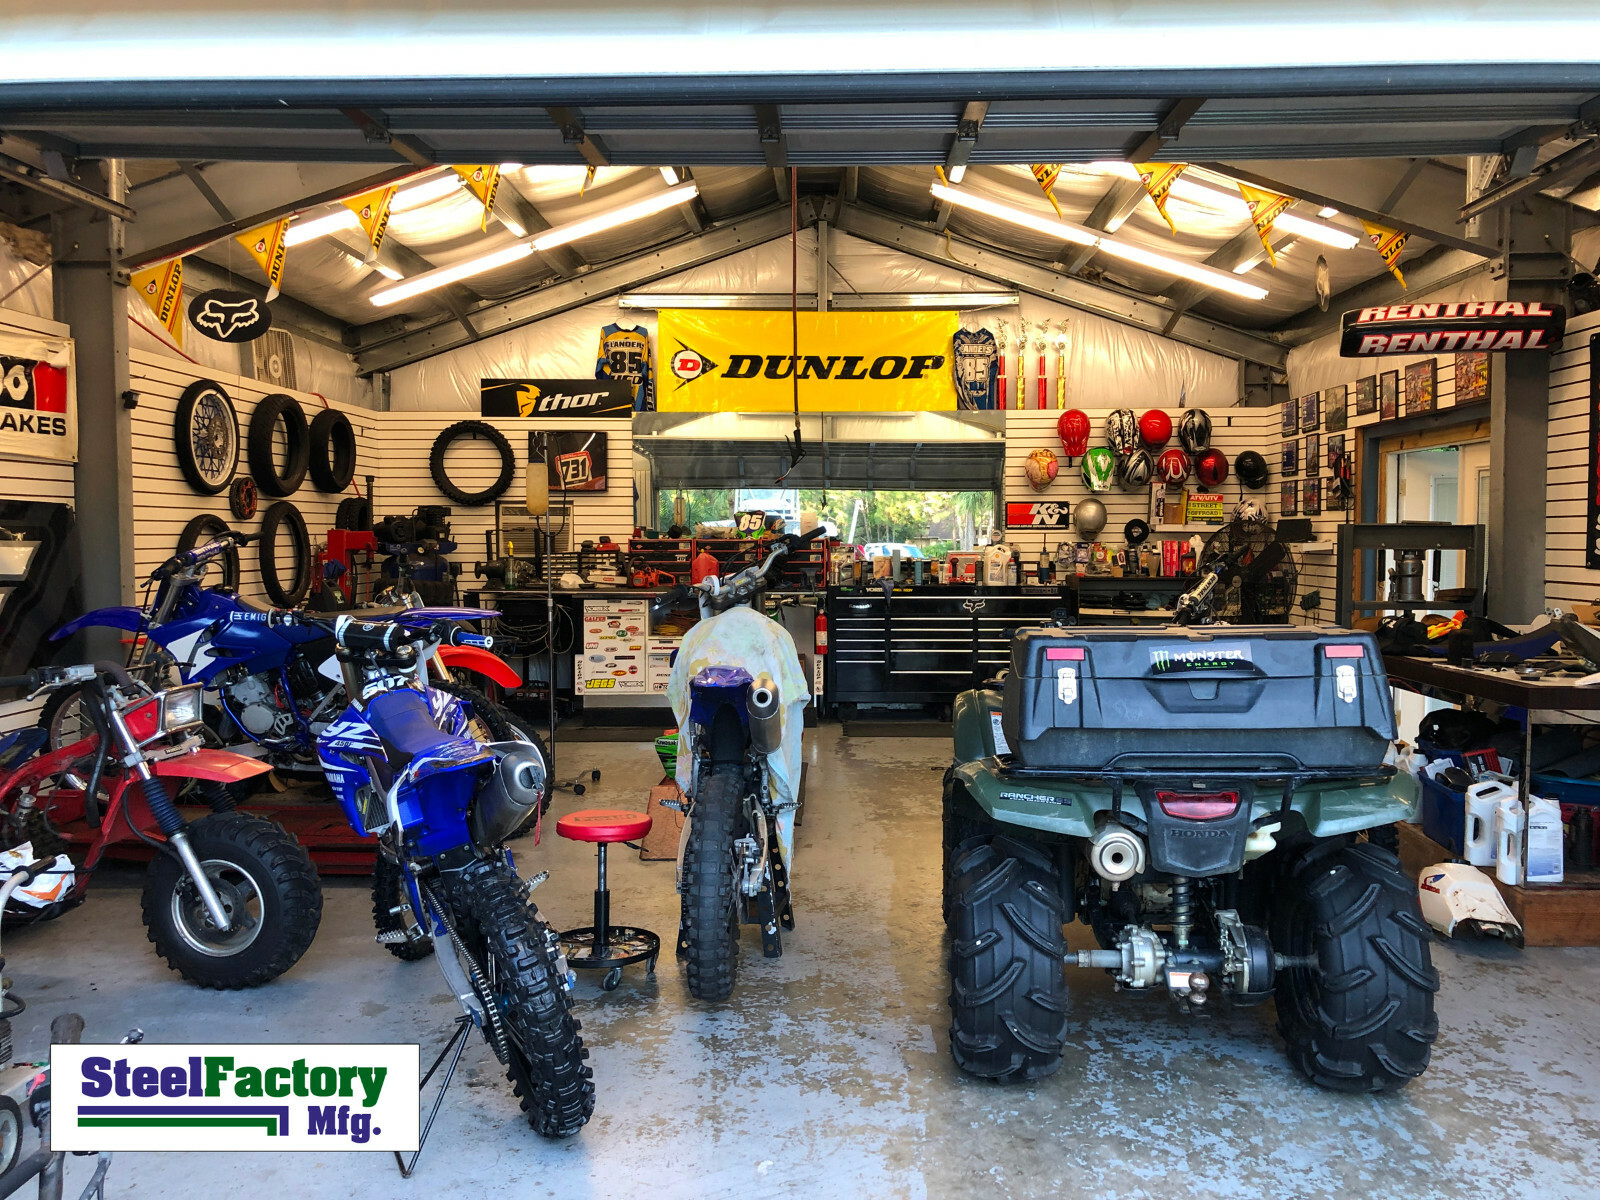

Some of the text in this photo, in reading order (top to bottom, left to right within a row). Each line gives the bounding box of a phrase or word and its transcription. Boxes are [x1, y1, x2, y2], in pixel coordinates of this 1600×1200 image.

[160, 264, 182, 323] DUNLOP
[1357, 301, 1553, 323] RENTHAL
[1358, 329, 1549, 354] RENTHAL
[611, 351, 642, 374] 85
[677, 358, 701, 371] D
[720, 354, 946, 380] DUNLOP
[963, 357, 989, 382] 85
[538, 391, 610, 412] thor
[560, 457, 587, 481] 731
[738, 514, 763, 532] 85
[244, 613, 267, 621] EMIG
[1173, 650, 1244, 662] MONSTER
[586, 679, 616, 690] JEGS
[1000, 792, 1055, 802] RANCHER
[1171, 829, 1230, 838] HONDA
